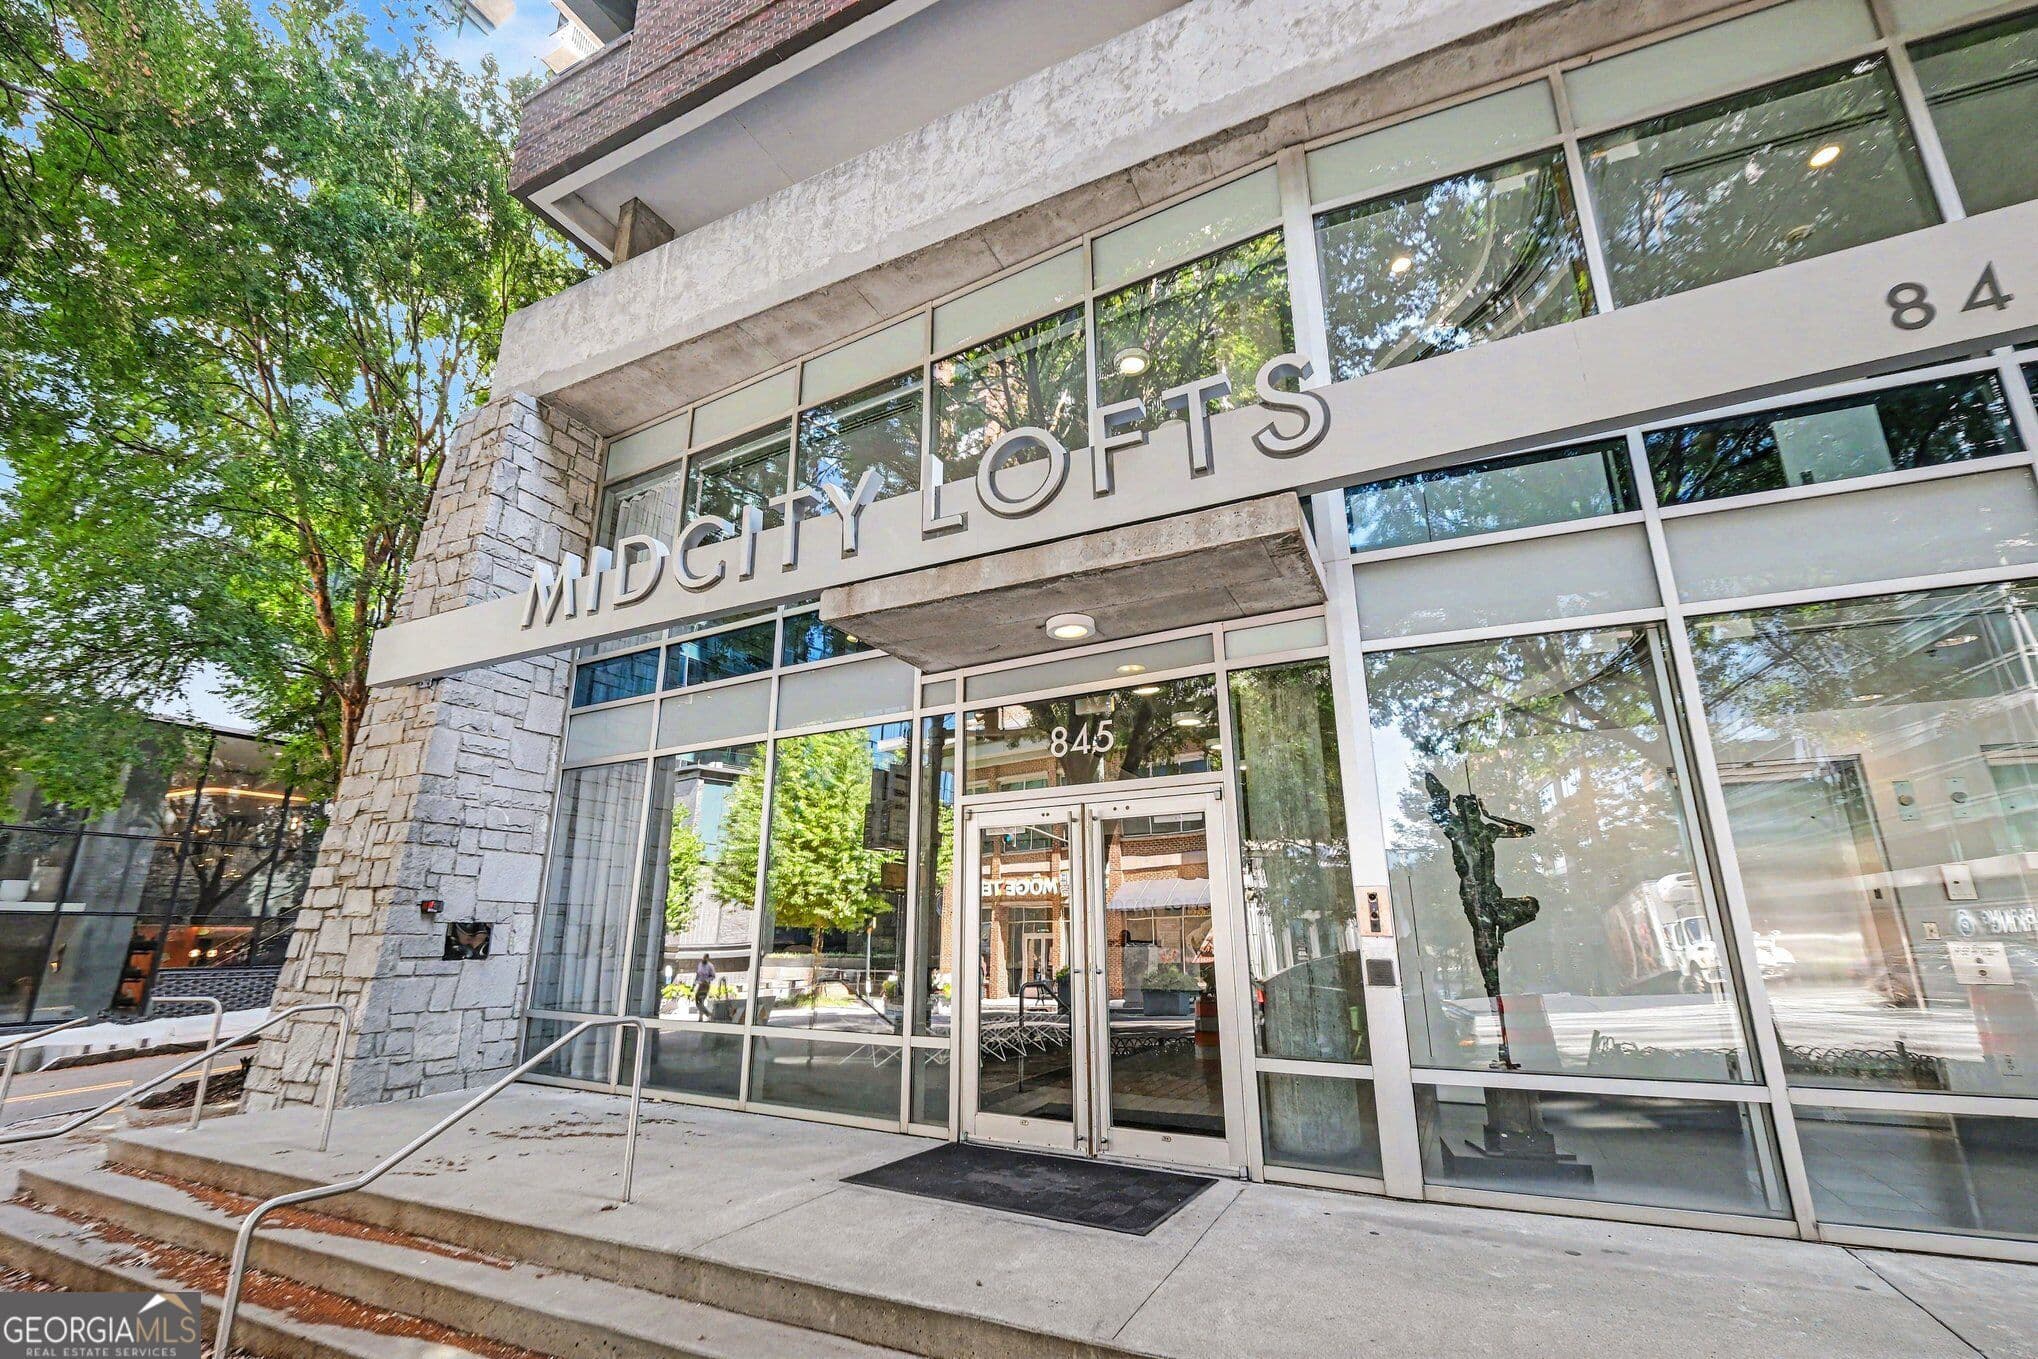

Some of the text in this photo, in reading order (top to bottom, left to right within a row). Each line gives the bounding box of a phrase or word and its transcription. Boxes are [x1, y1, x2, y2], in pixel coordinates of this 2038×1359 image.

[1887, 260, 2014, 330] 84
[521, 353, 1328, 629] MIDCITY LOFTS
[1051, 720, 1113, 757] 845
